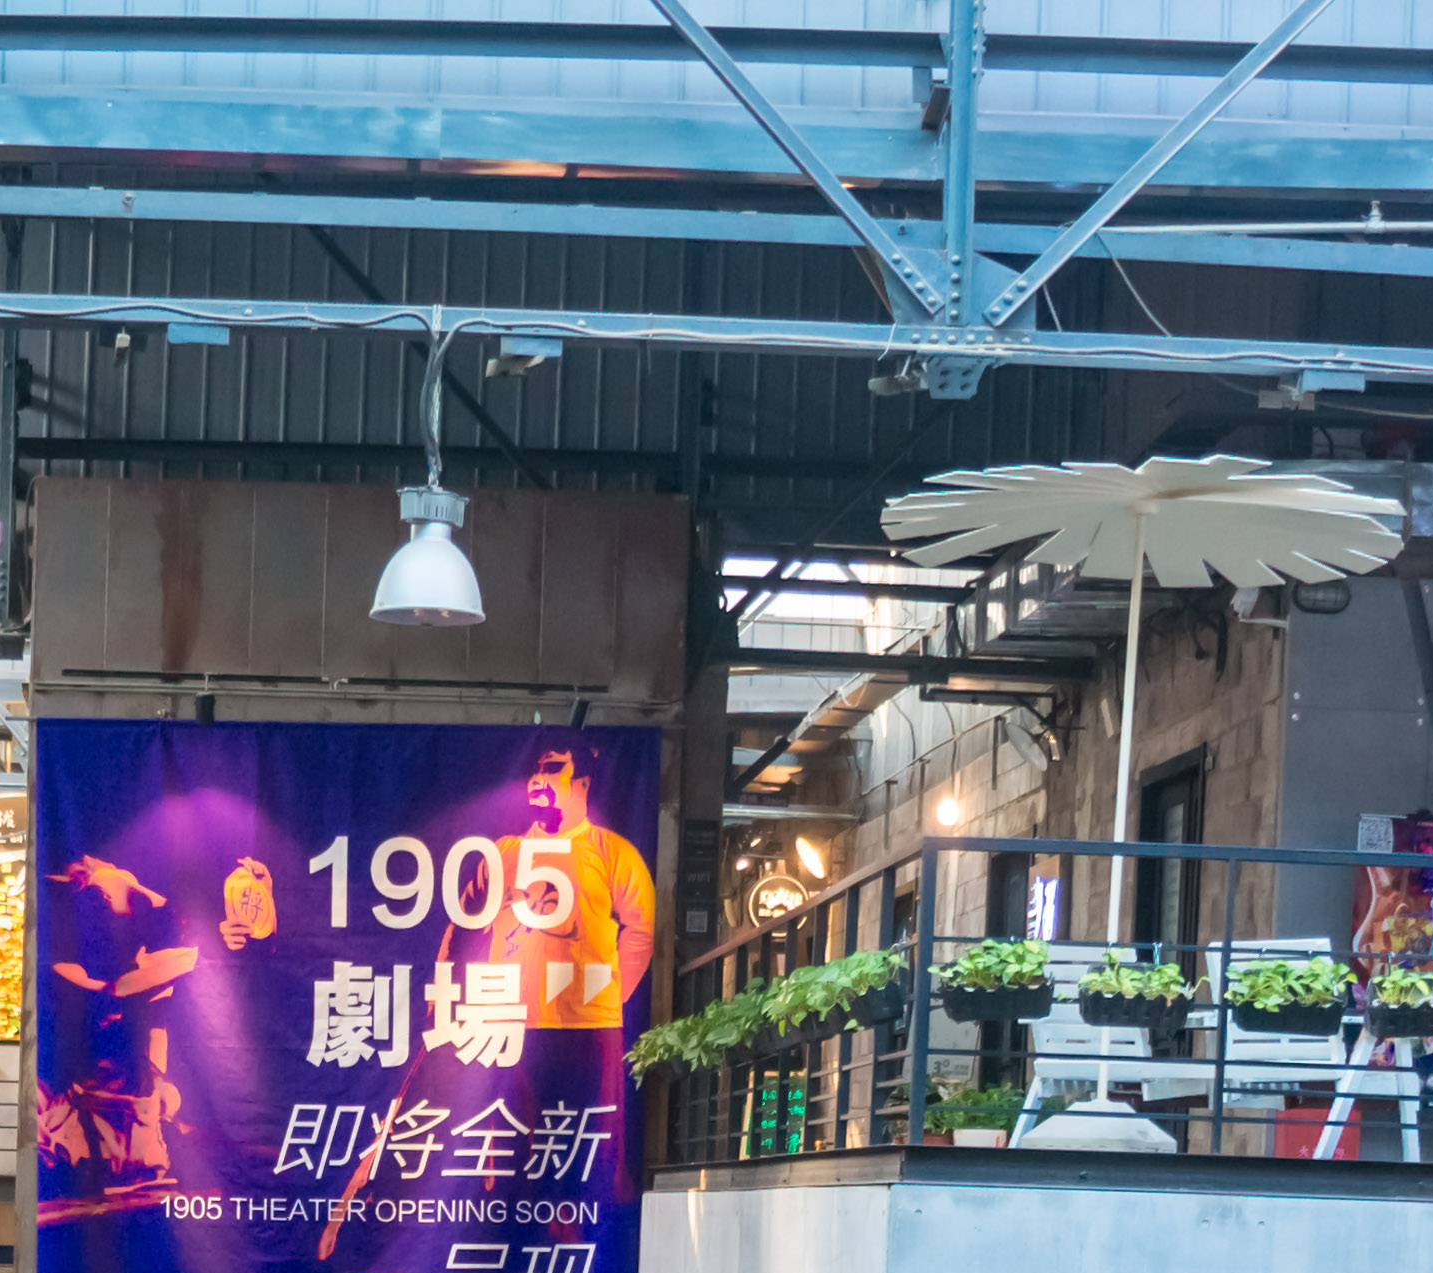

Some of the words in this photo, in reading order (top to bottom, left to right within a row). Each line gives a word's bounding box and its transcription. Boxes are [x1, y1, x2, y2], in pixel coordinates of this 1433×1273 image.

[309, 835, 576, 930] 1905
[273, 1098, 617, 1182] 即将全新
[160, 1195, 222, 1220] 1905
[230, 1197, 366, 1223] THEATER
[375, 1199, 508, 1224] OPENING
[515, 1202, 598, 1225] SOON
